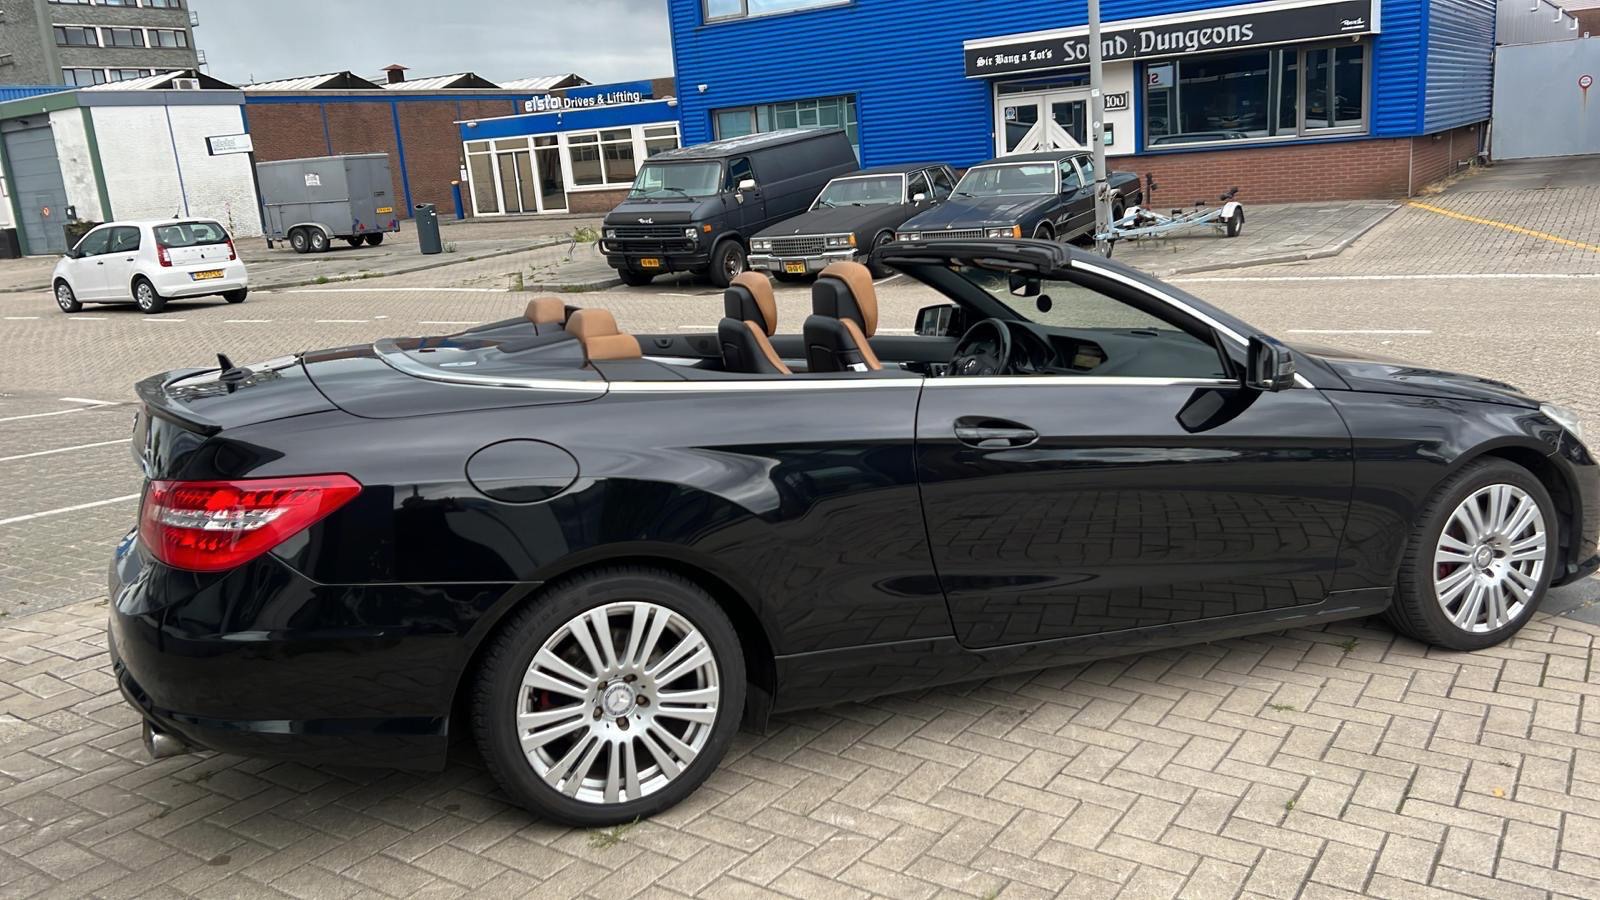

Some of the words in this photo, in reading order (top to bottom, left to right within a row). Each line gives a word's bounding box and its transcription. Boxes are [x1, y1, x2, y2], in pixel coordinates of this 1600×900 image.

[976, 56, 993, 68] Sir
[994, 53, 1020, 66] Bang
[1021, 52, 1028, 62] a
[1029, 48, 1053, 61] Lot's
[1063, 35, 1128, 61] Sond
[1139, 23, 1254, 52] Dungeons
[563, 96, 595, 109] Drives
[597, 93, 605, 105] &
[607, 90, 640, 104] Lifting
[1105, 94, 1124, 108] 100
